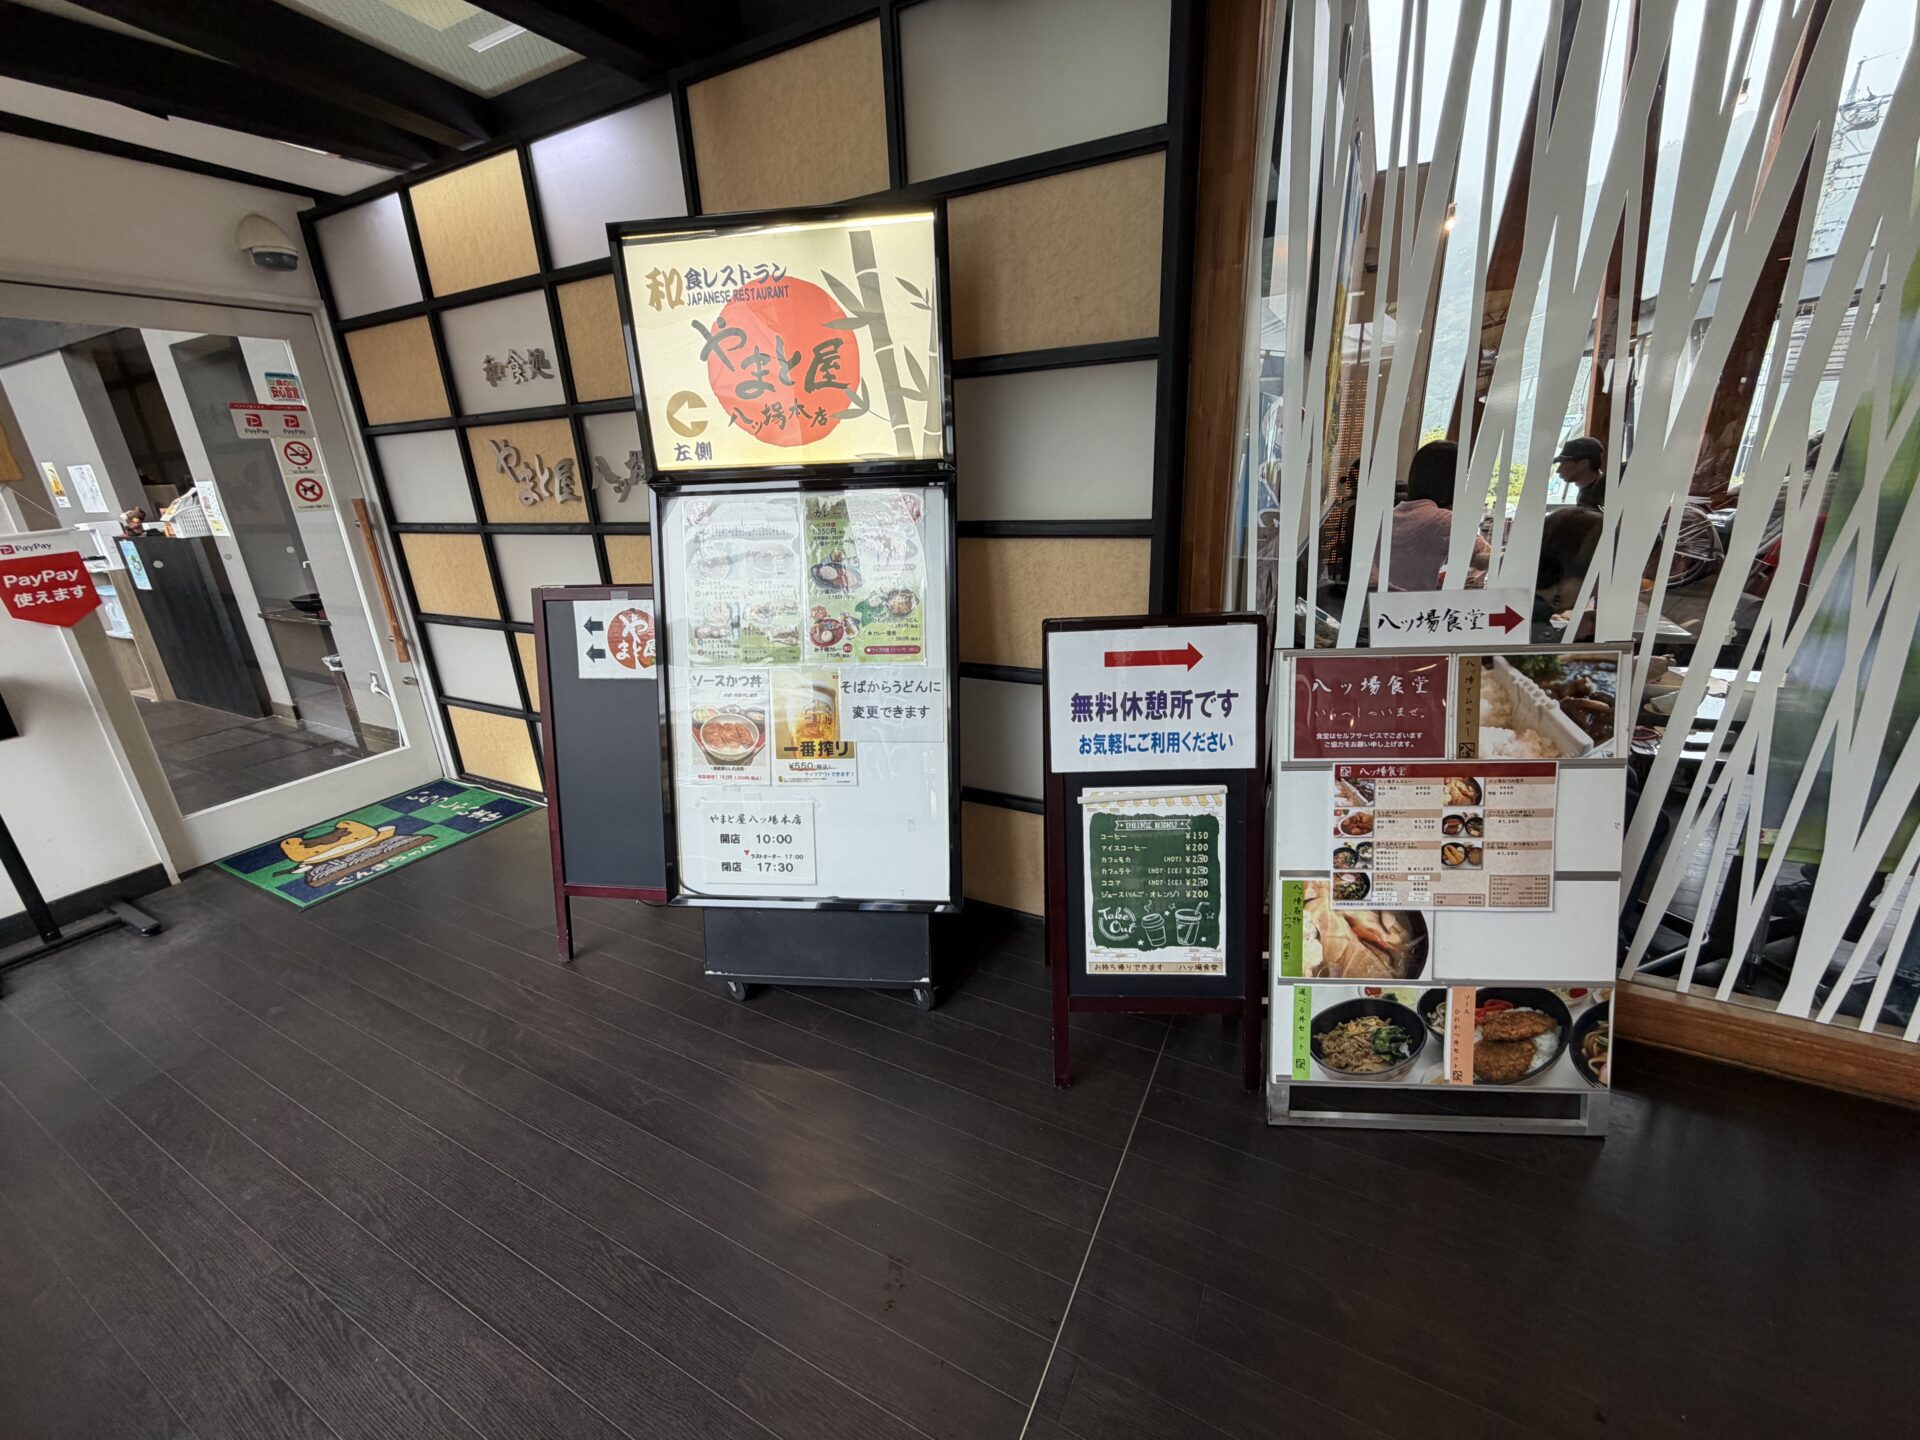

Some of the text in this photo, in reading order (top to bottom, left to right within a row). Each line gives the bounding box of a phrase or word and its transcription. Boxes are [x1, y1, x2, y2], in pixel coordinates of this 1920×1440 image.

[687, 285, 789, 307] JAPANESE RESTAURANT
[691, 316, 850, 400] やまと屋
[483, 348, 554, 387] 和食処
[728, 399, 828, 435] 八ッ場本店
[673, 442, 713, 462] 左側
[490, 438, 582, 506] やまと屋
[15, 542, 52, 553] PayPay
[3, 568, 79, 589] PayPay
[13, 584, 87, 608] 使えます
[1377, 607, 1485, 636] 八ッ場食堂
[692, 674, 762, 688] ソースかつ丼
[840, 680, 941, 693] そばからうどんに
[1311, 675, 1430, 696] 八ッ場食堂
[852, 705, 930, 719] 変更できます
[1070, 688, 1239, 723] 無料休憩所です
[783, 740, 849, 758] 一番搾り
[1079, 730, 1234, 755] お気軽にご利用ください
[1125, 821, 1178, 829] DRINK MENU
[720, 834, 793, 844] 開店 10:00
[1185, 831, 1209, 840] ¥150
[1185, 843, 1209, 851] ¥200
[336, 844, 438, 886] ぐんまちゃん
[721, 862, 794, 872] 閉店 17:30
[1185, 889, 1209, 898] ¥200
[1098, 906, 1131, 921] Take
[1109, 920, 1137, 934] Out
[1094, 963, 1164, 971] お持ち帰りできます
